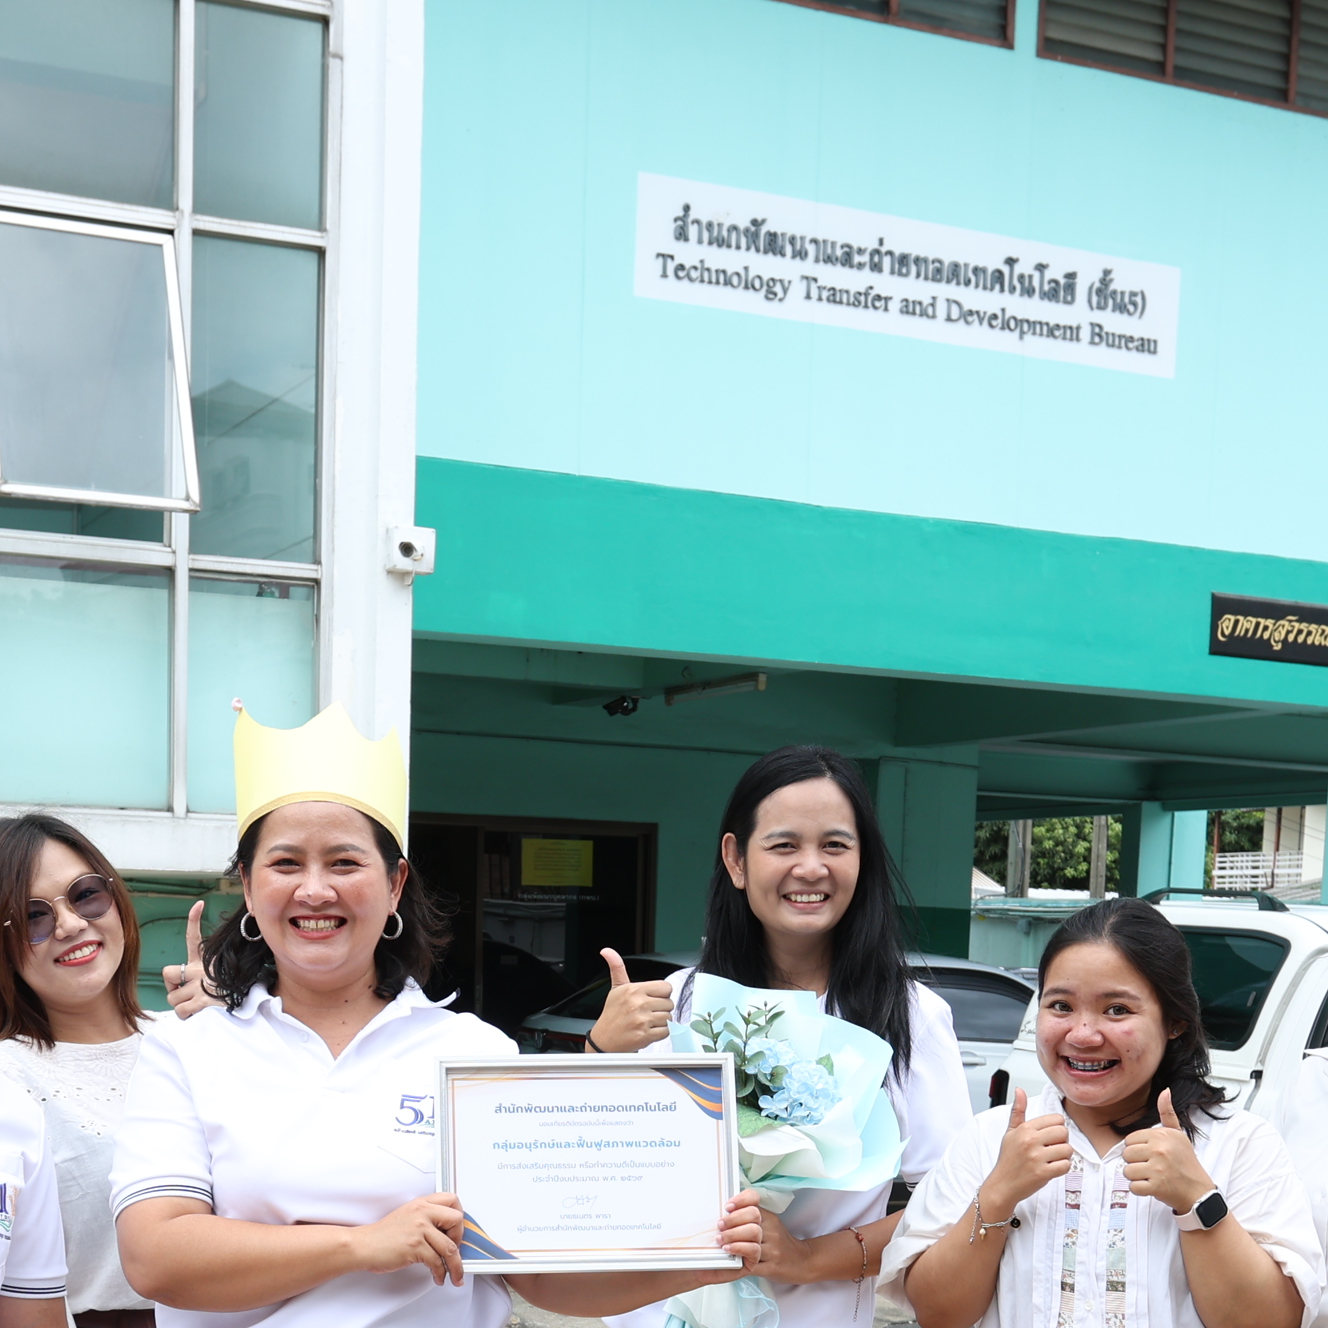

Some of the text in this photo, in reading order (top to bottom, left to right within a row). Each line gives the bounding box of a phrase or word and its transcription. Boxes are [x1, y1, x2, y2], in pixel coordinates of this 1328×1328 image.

[656, 252, 1159, 355] Technology Transfer and Development Bureau
[494, 1101, 677, 1114] สำนักพัฒนาและถ่ายทอดเทคโนโลยี
[492, 1136, 681, 1153] กลุ่มอนุรักษ์และฟื้นฟูสภาพแวดล้อม
